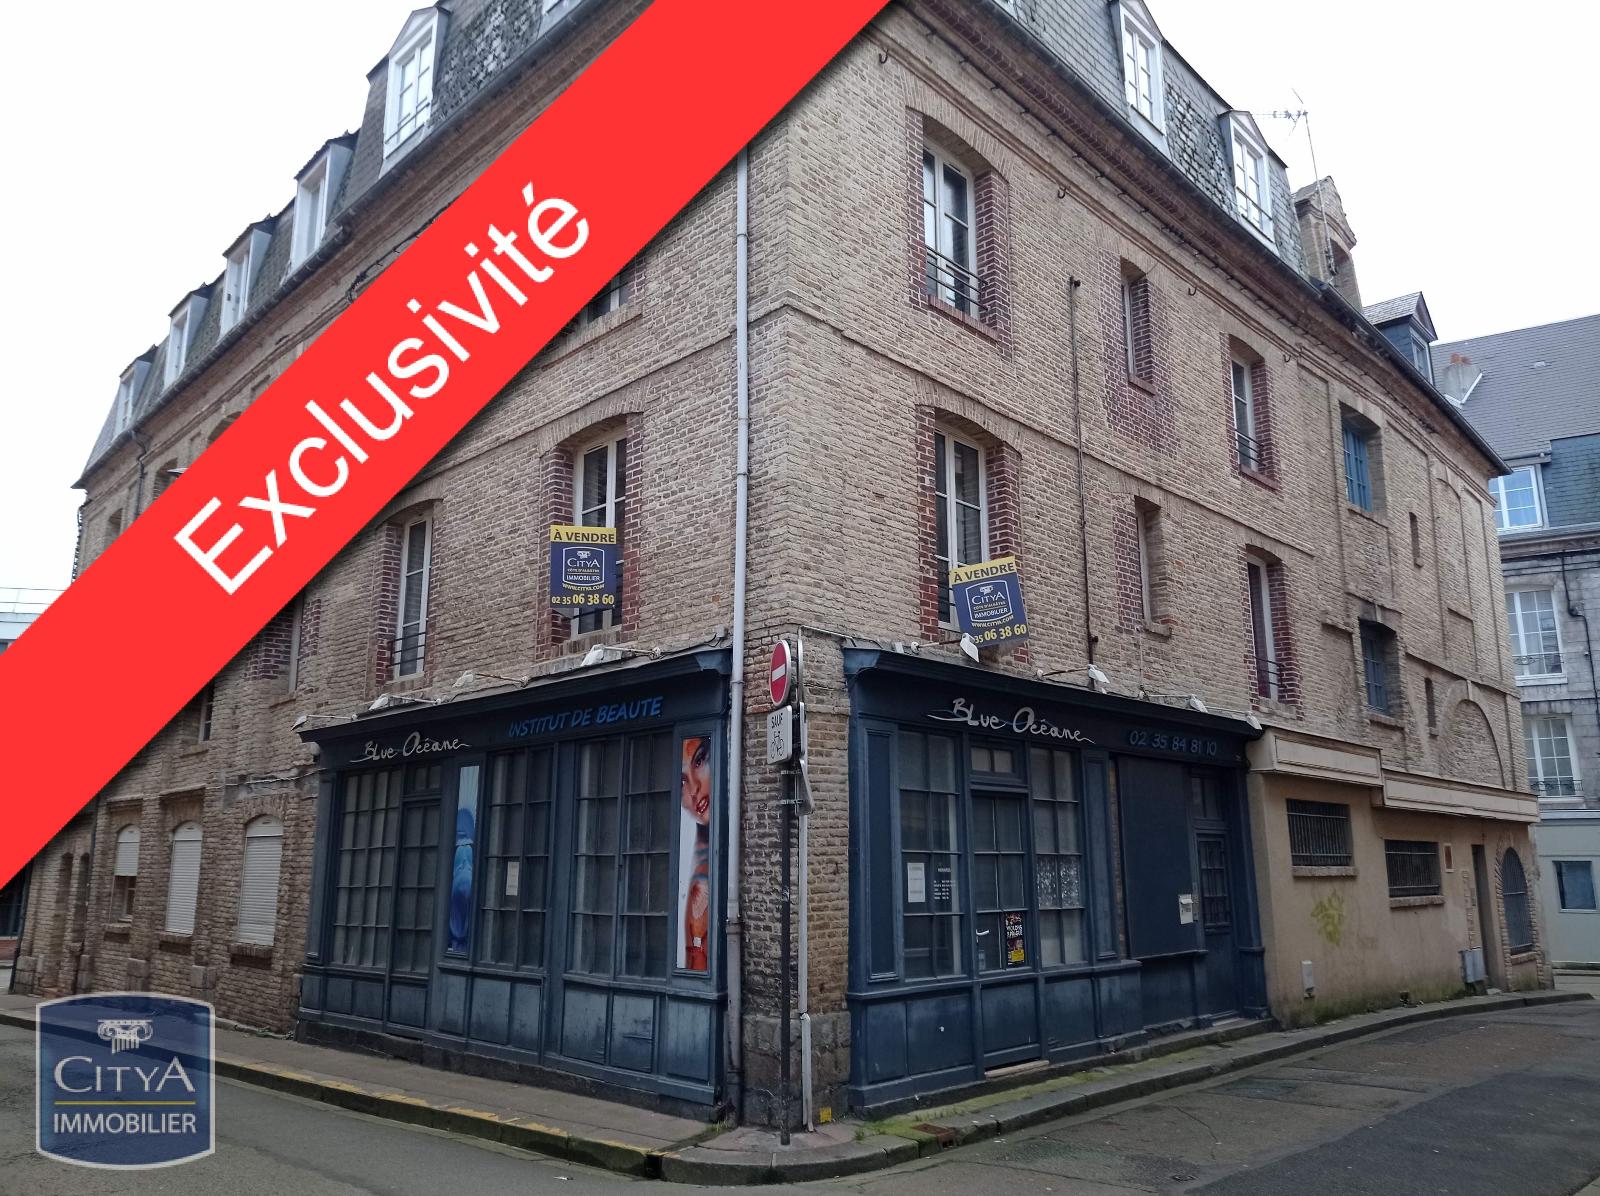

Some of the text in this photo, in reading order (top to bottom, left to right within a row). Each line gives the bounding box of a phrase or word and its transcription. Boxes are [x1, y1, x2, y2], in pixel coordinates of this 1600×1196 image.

[553, 529, 615, 543] À VENDRE
[953, 562, 1015, 583] À VENDRE
[551, 593, 615, 606] 02 35 06 38 60
[974, 607, 1009, 619] IMMOBILIER
[974, 623, 1027, 644] 35 06 38 60
[508, 712, 571, 737] INSTITUT
[571, 707, 593, 728] DE
[771, 712, 783, 729] SAUF
[402, 731, 473, 757] Océane
[1129, 730, 1217, 756] 02 35 84 81 10
